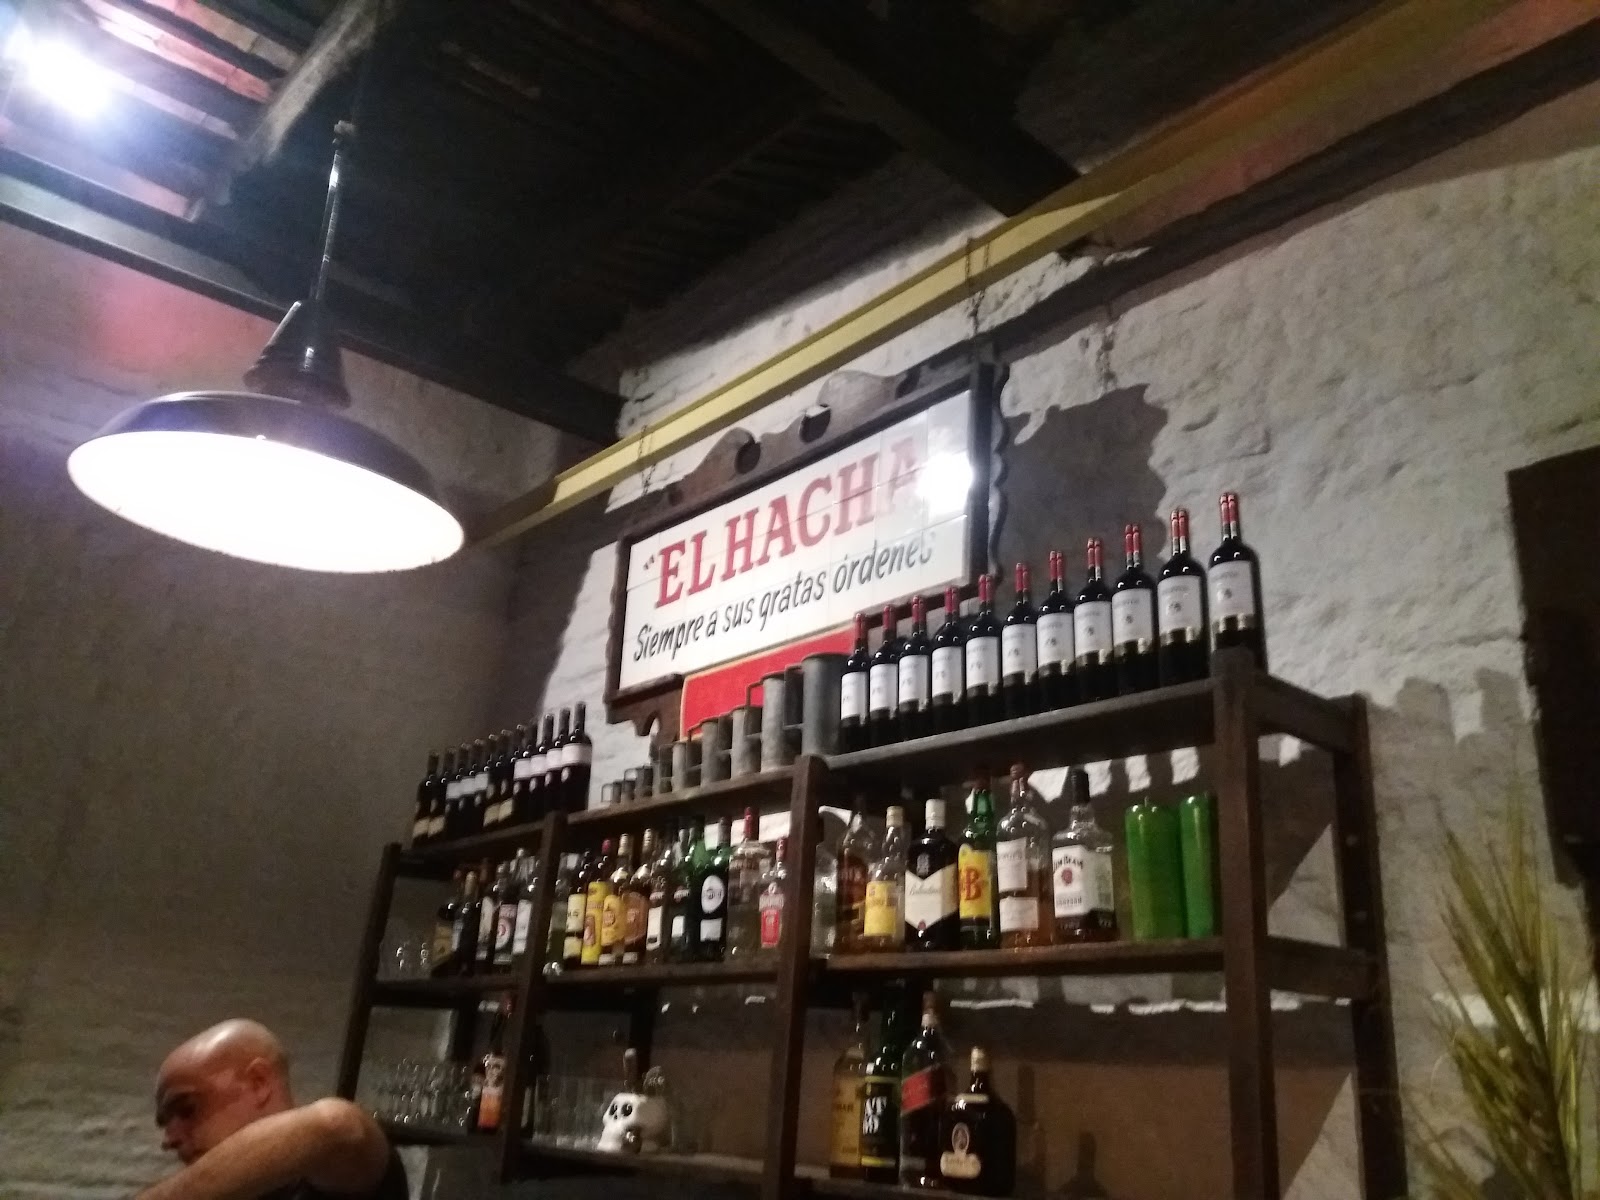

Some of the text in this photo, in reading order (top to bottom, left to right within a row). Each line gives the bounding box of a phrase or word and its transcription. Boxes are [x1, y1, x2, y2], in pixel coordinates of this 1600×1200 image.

[633, 623, 704, 662] Siempre
[706, 610, 718, 638] a
[722, 597, 755, 633] sus
[759, 570, 827, 632] gratas
